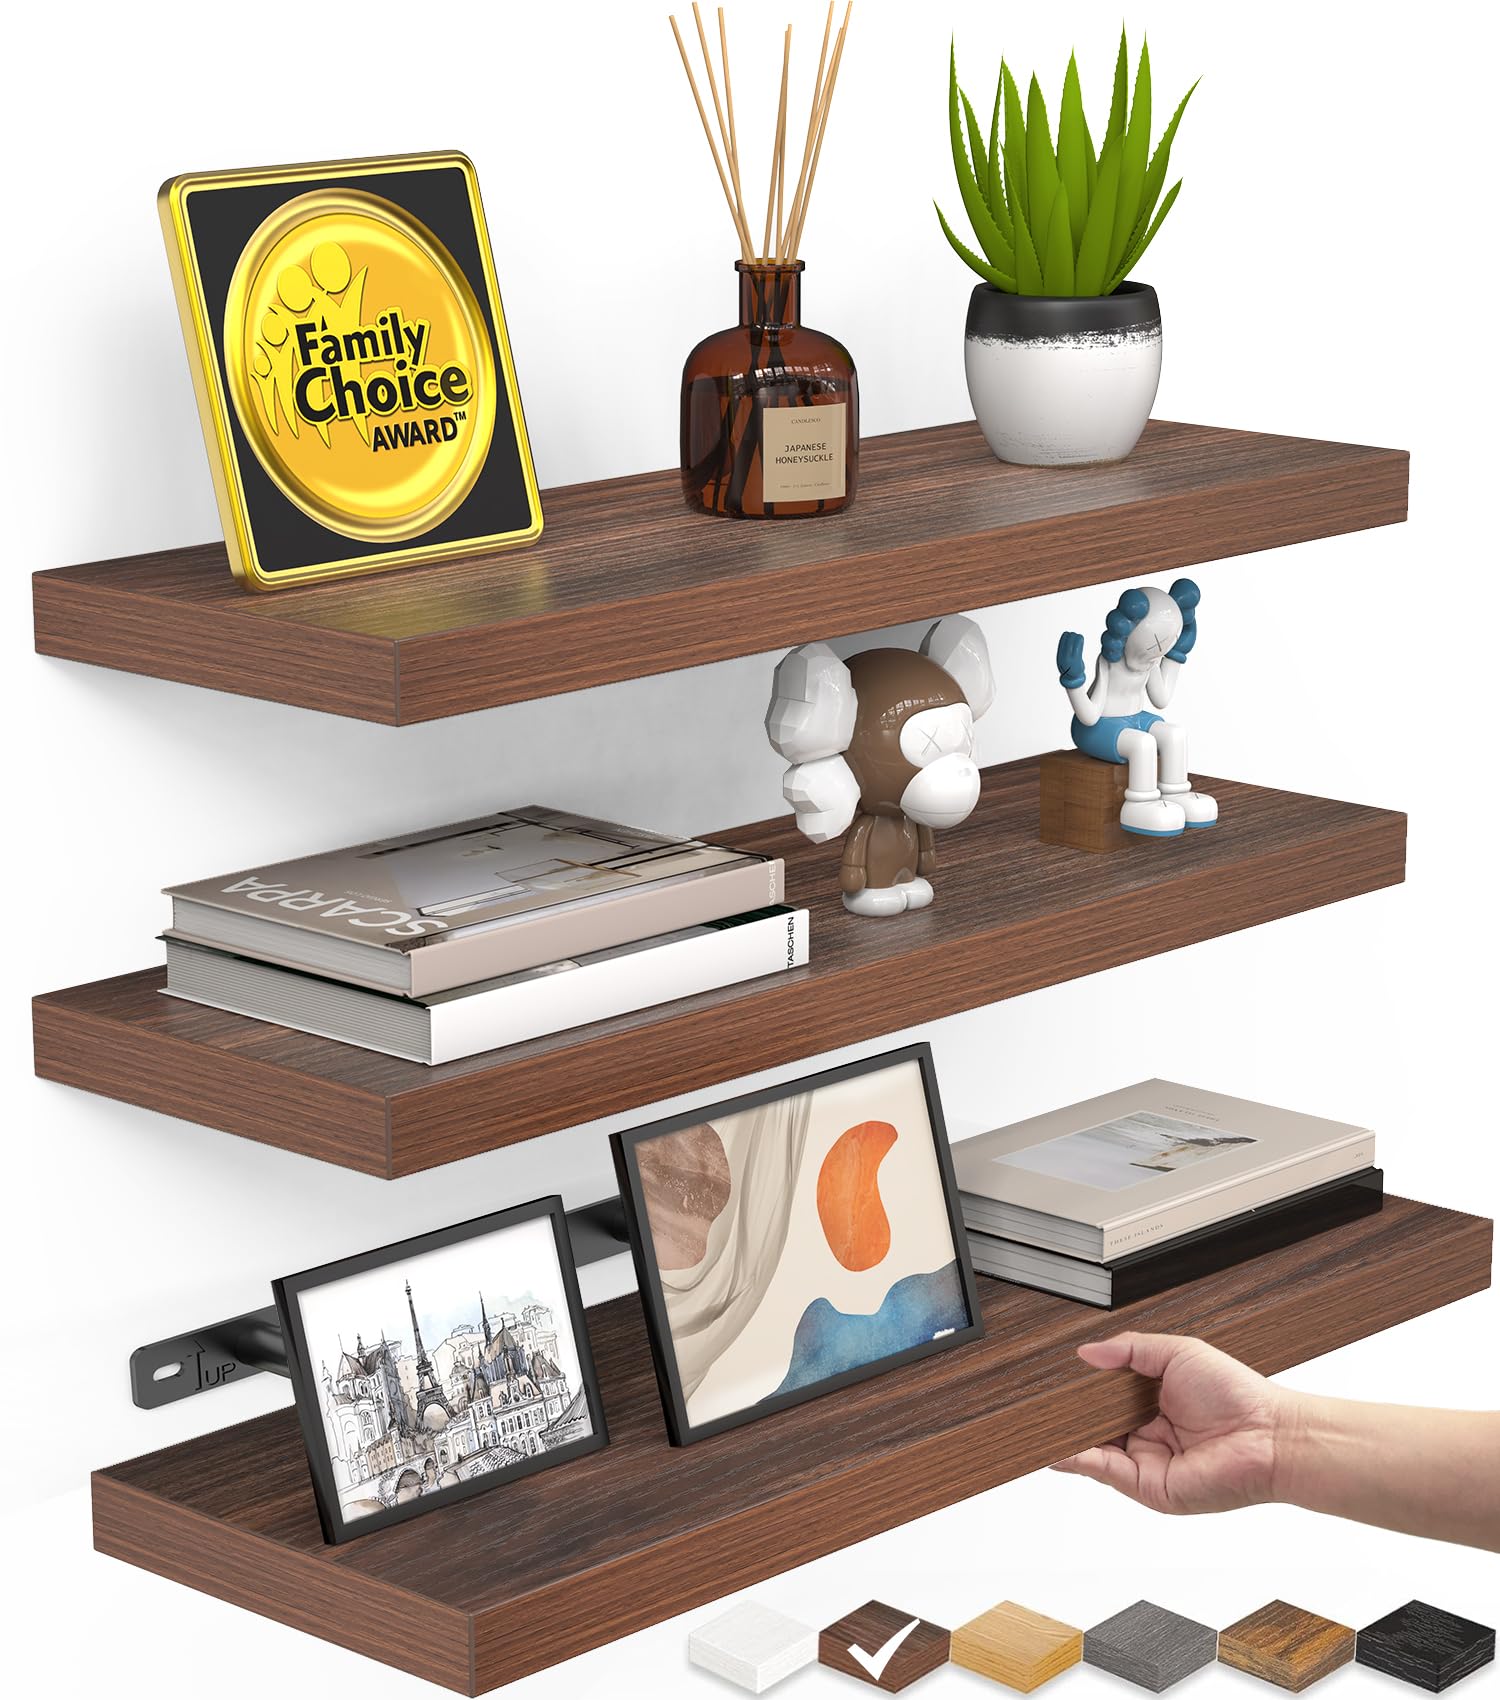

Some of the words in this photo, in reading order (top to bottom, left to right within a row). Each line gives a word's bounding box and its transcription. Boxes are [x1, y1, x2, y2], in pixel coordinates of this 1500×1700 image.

[295, 312, 425, 366] Family
[295, 359, 469, 423] Choice
[775, 453, 833, 465] HONEYSUCKLE
[784, 442, 827, 453] JAPANESE
[221, 876, 449, 936] SCARPA
[768, 860, 777, 906] ASCHE
[787, 916, 795, 969] TASCHEN
[205, 1362, 237, 1386] UP
